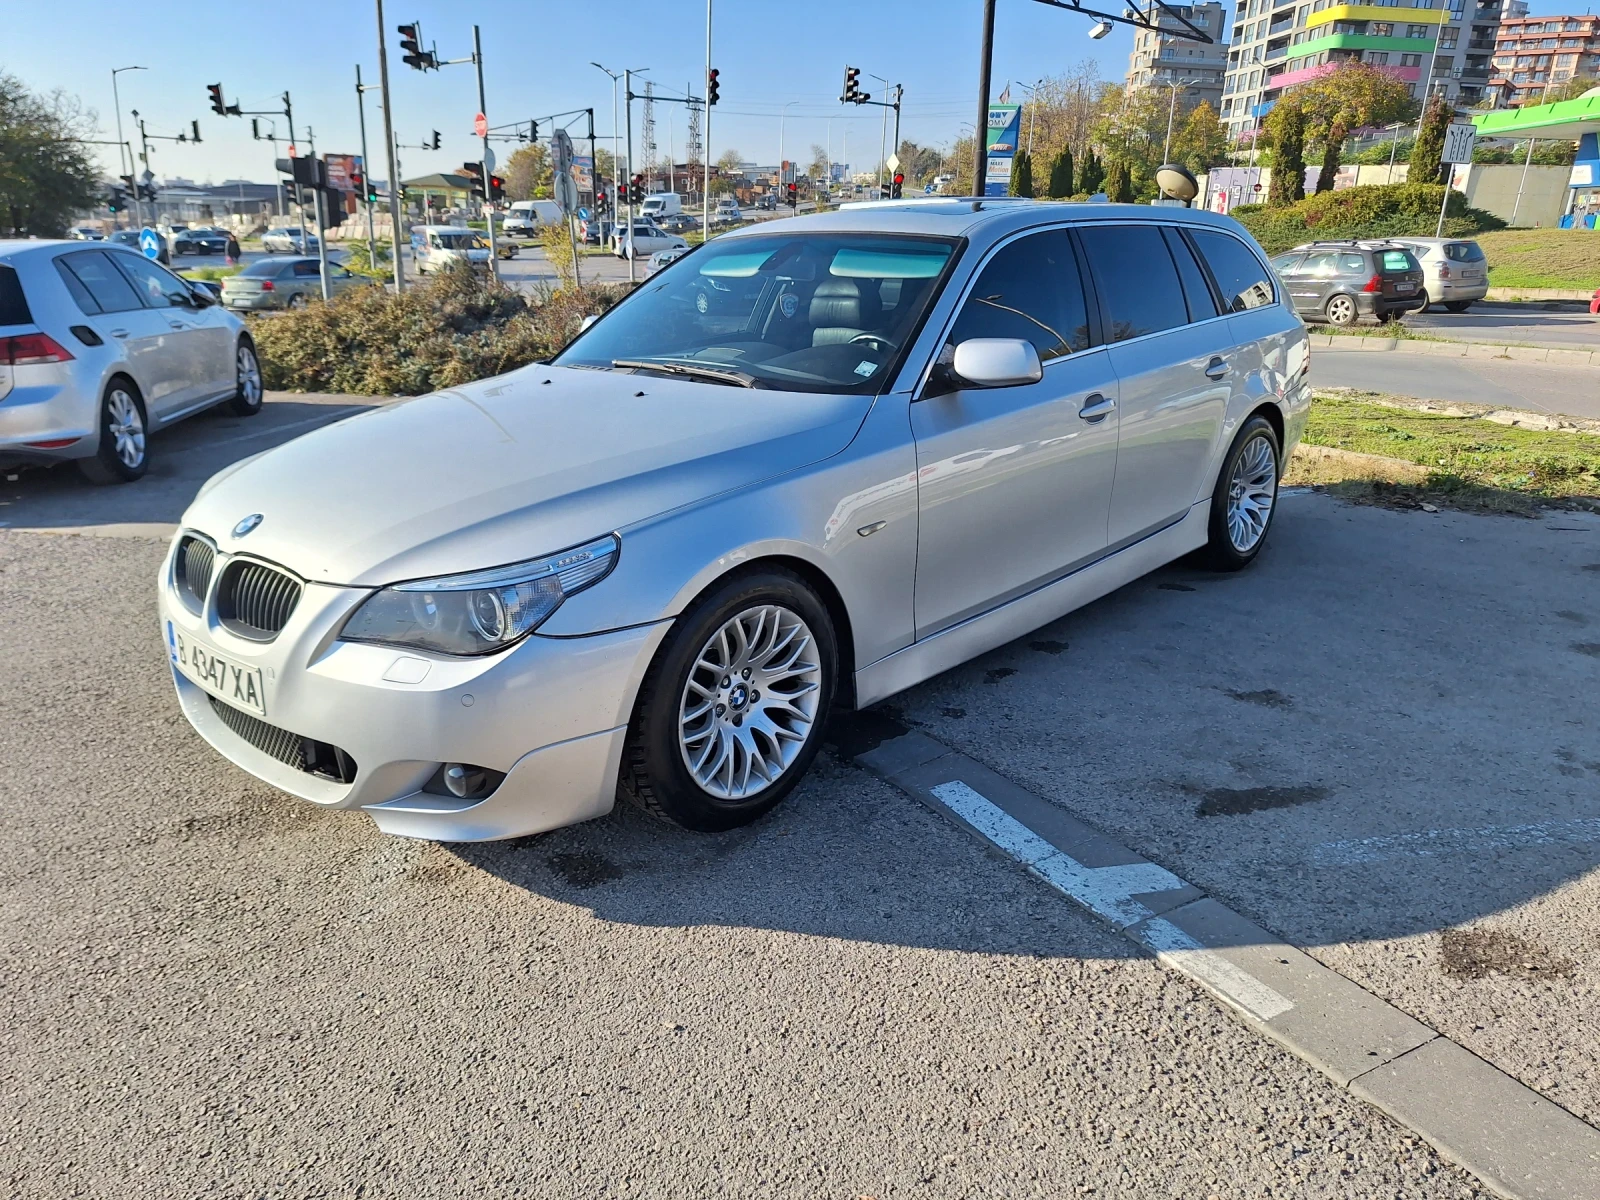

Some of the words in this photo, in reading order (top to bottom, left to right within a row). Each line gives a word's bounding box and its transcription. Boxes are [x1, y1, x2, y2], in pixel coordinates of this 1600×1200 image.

[178, 633, 187, 665] B
[192, 646, 226, 691] 4347
[230, 664, 260, 708] XA
